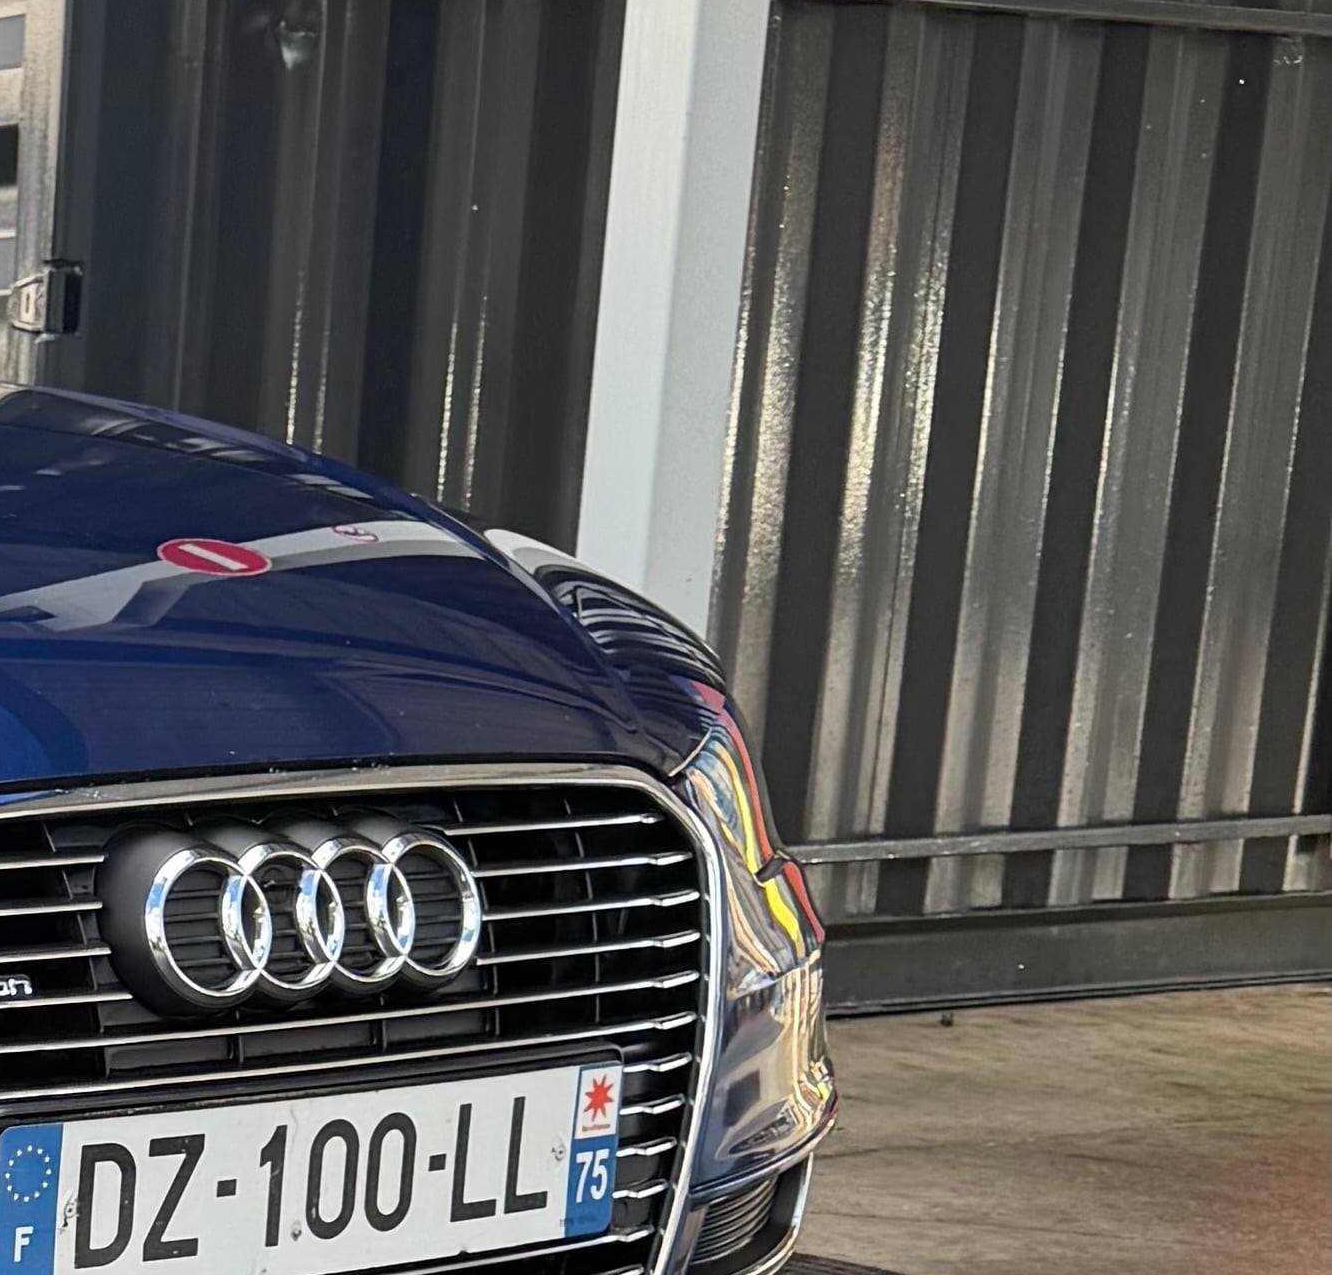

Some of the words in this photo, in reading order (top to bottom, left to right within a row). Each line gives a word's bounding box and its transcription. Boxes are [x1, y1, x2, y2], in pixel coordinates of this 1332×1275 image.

[73, 1096, 549, 1269] DZ-100-LL
[574, 1148, 610, 1204] 75
[13, 1226, 34, 1263] F
